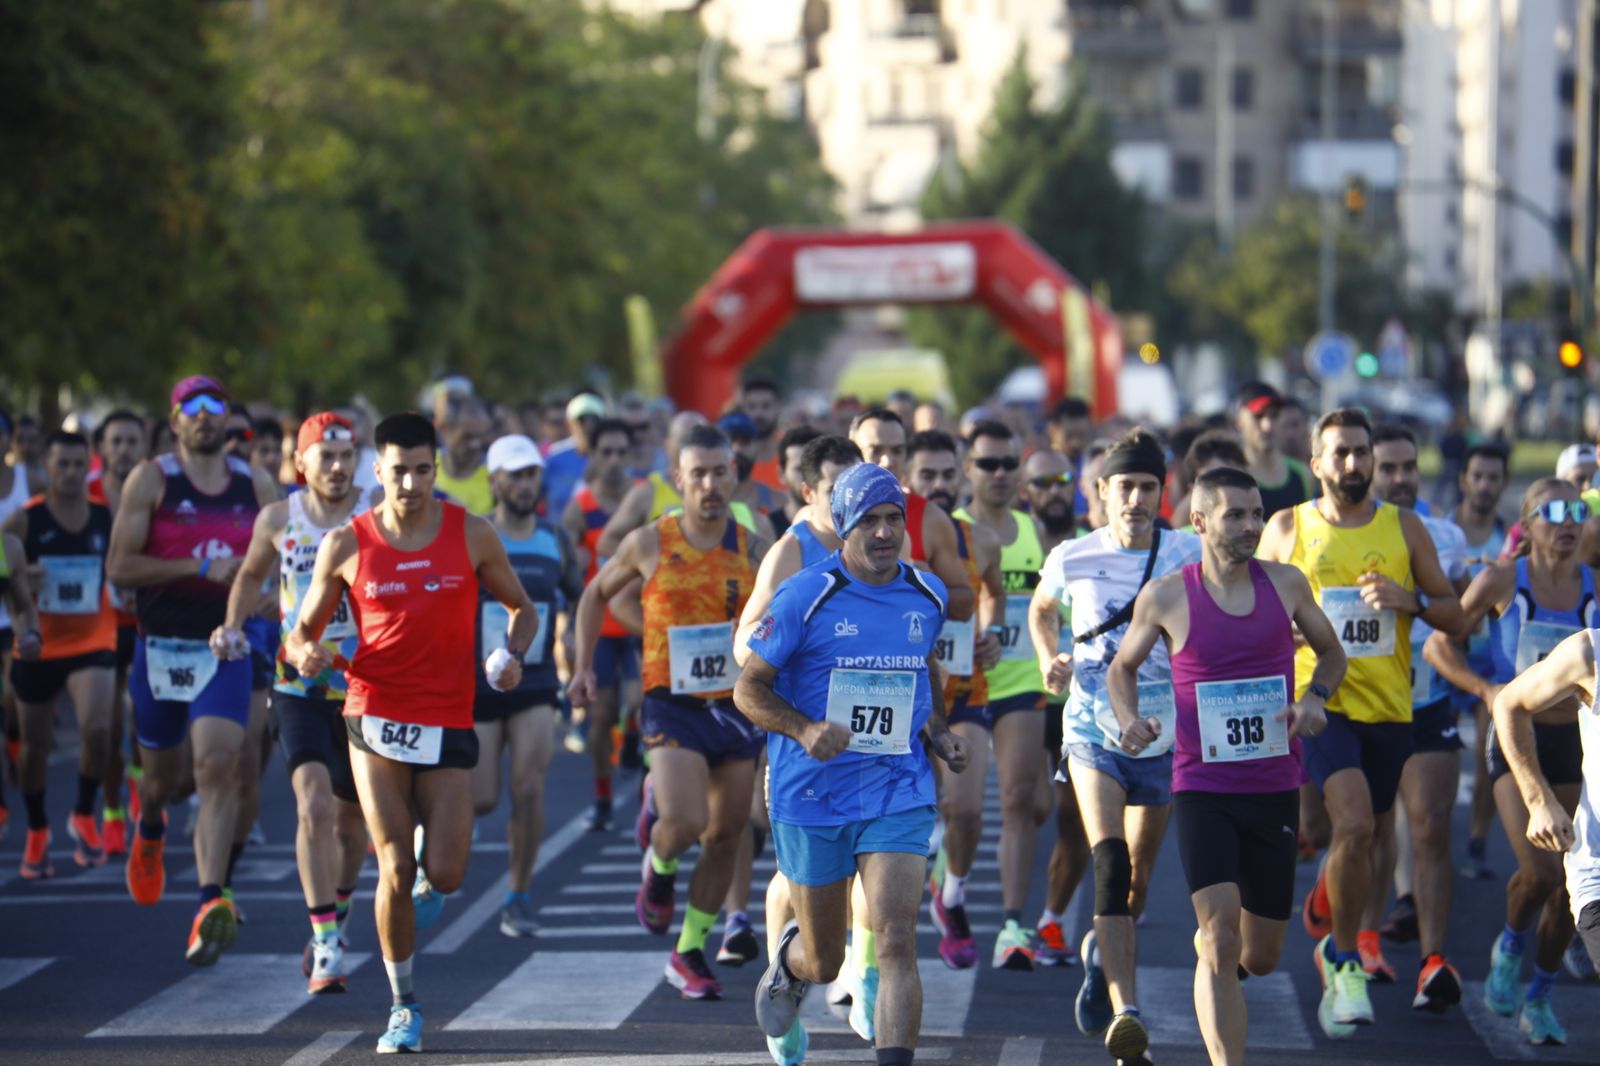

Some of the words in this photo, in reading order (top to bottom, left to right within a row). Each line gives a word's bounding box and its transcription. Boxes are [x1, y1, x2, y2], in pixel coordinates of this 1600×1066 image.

[690, 654, 727, 679] 482
[835, 655, 927, 669] TROTASIERRA
[833, 684, 865, 695] MEDIA
[1201, 696, 1234, 706] MEDIA
[851, 705, 893, 735] 579
[1226, 715, 1264, 746] 313
[381, 721, 422, 750] 542
